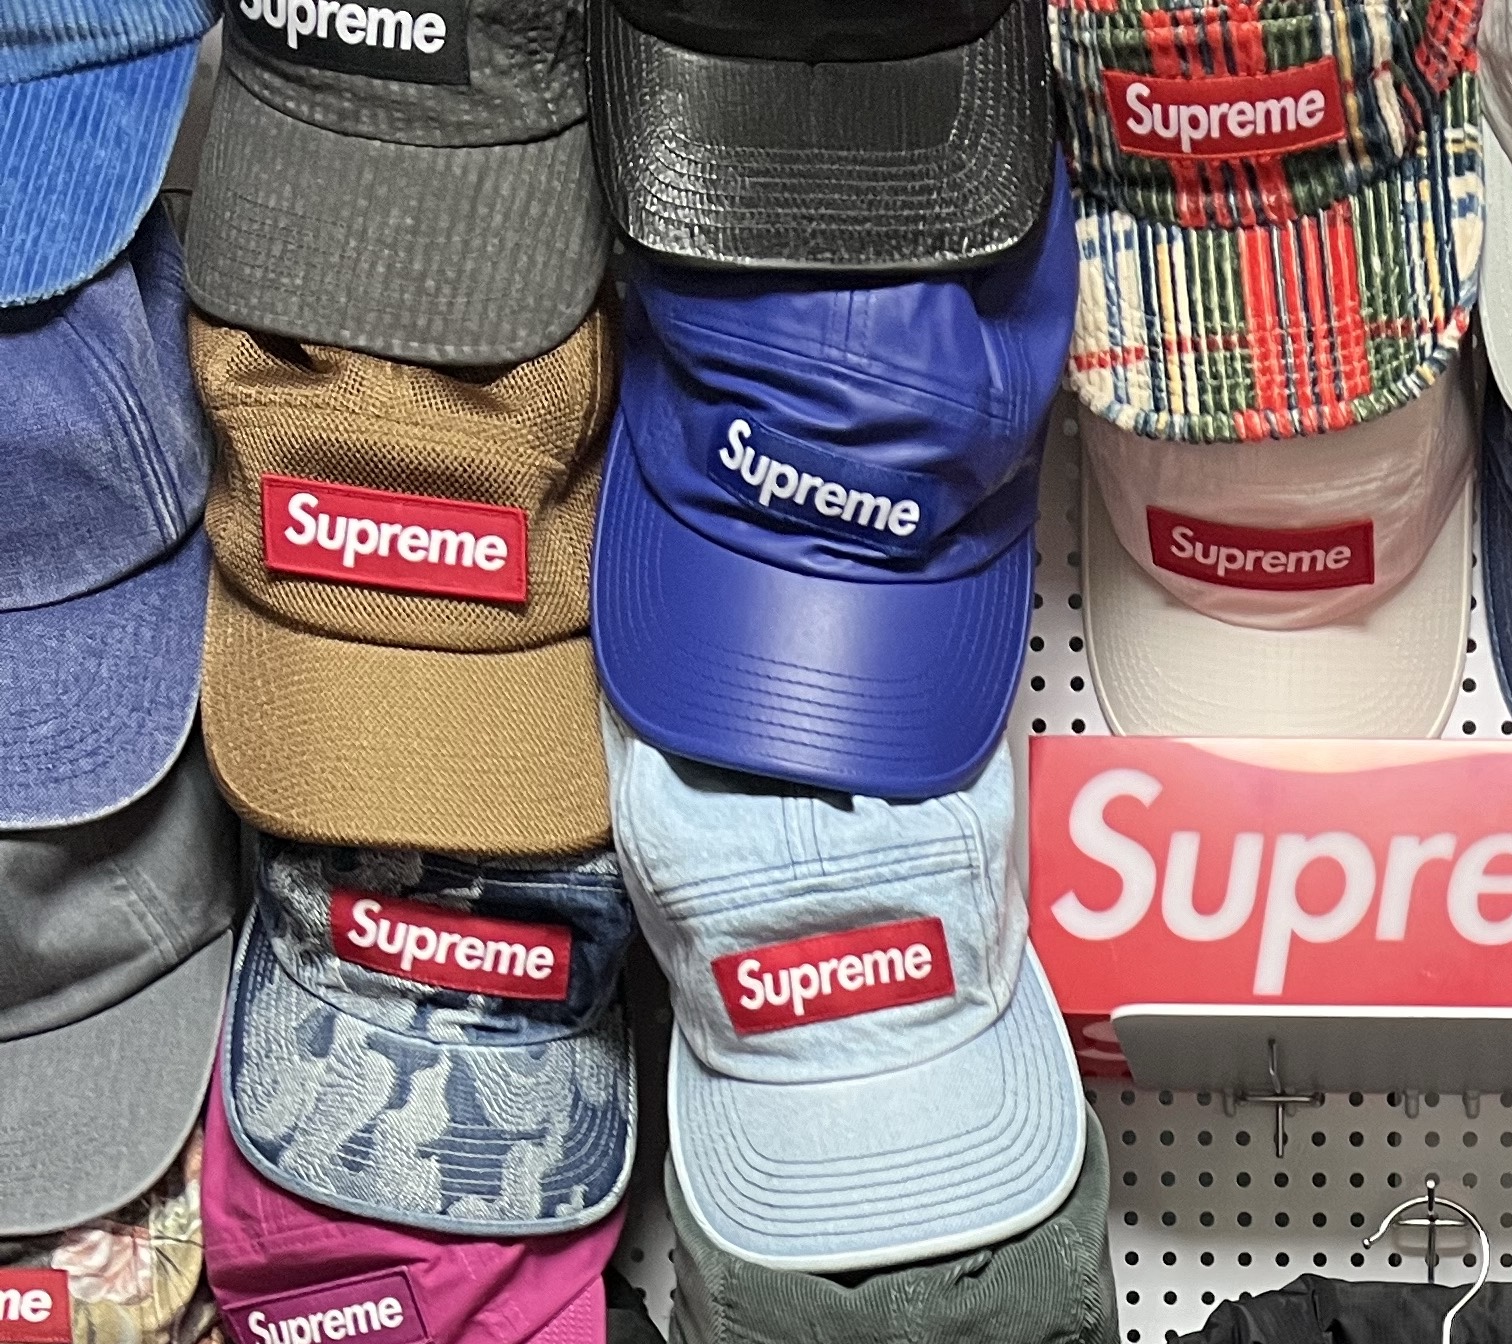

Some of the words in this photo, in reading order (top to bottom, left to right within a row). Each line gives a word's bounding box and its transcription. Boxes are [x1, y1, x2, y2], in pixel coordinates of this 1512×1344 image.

[1125, 82, 1325, 153] Supreme
[718, 419, 921, 536] Supreme
[284, 492, 508, 571] Supreme
[1169, 525, 1352, 575] Supreme
[347, 898, 555, 982] Supreme
[737, 942, 933, 1016] Supreme
